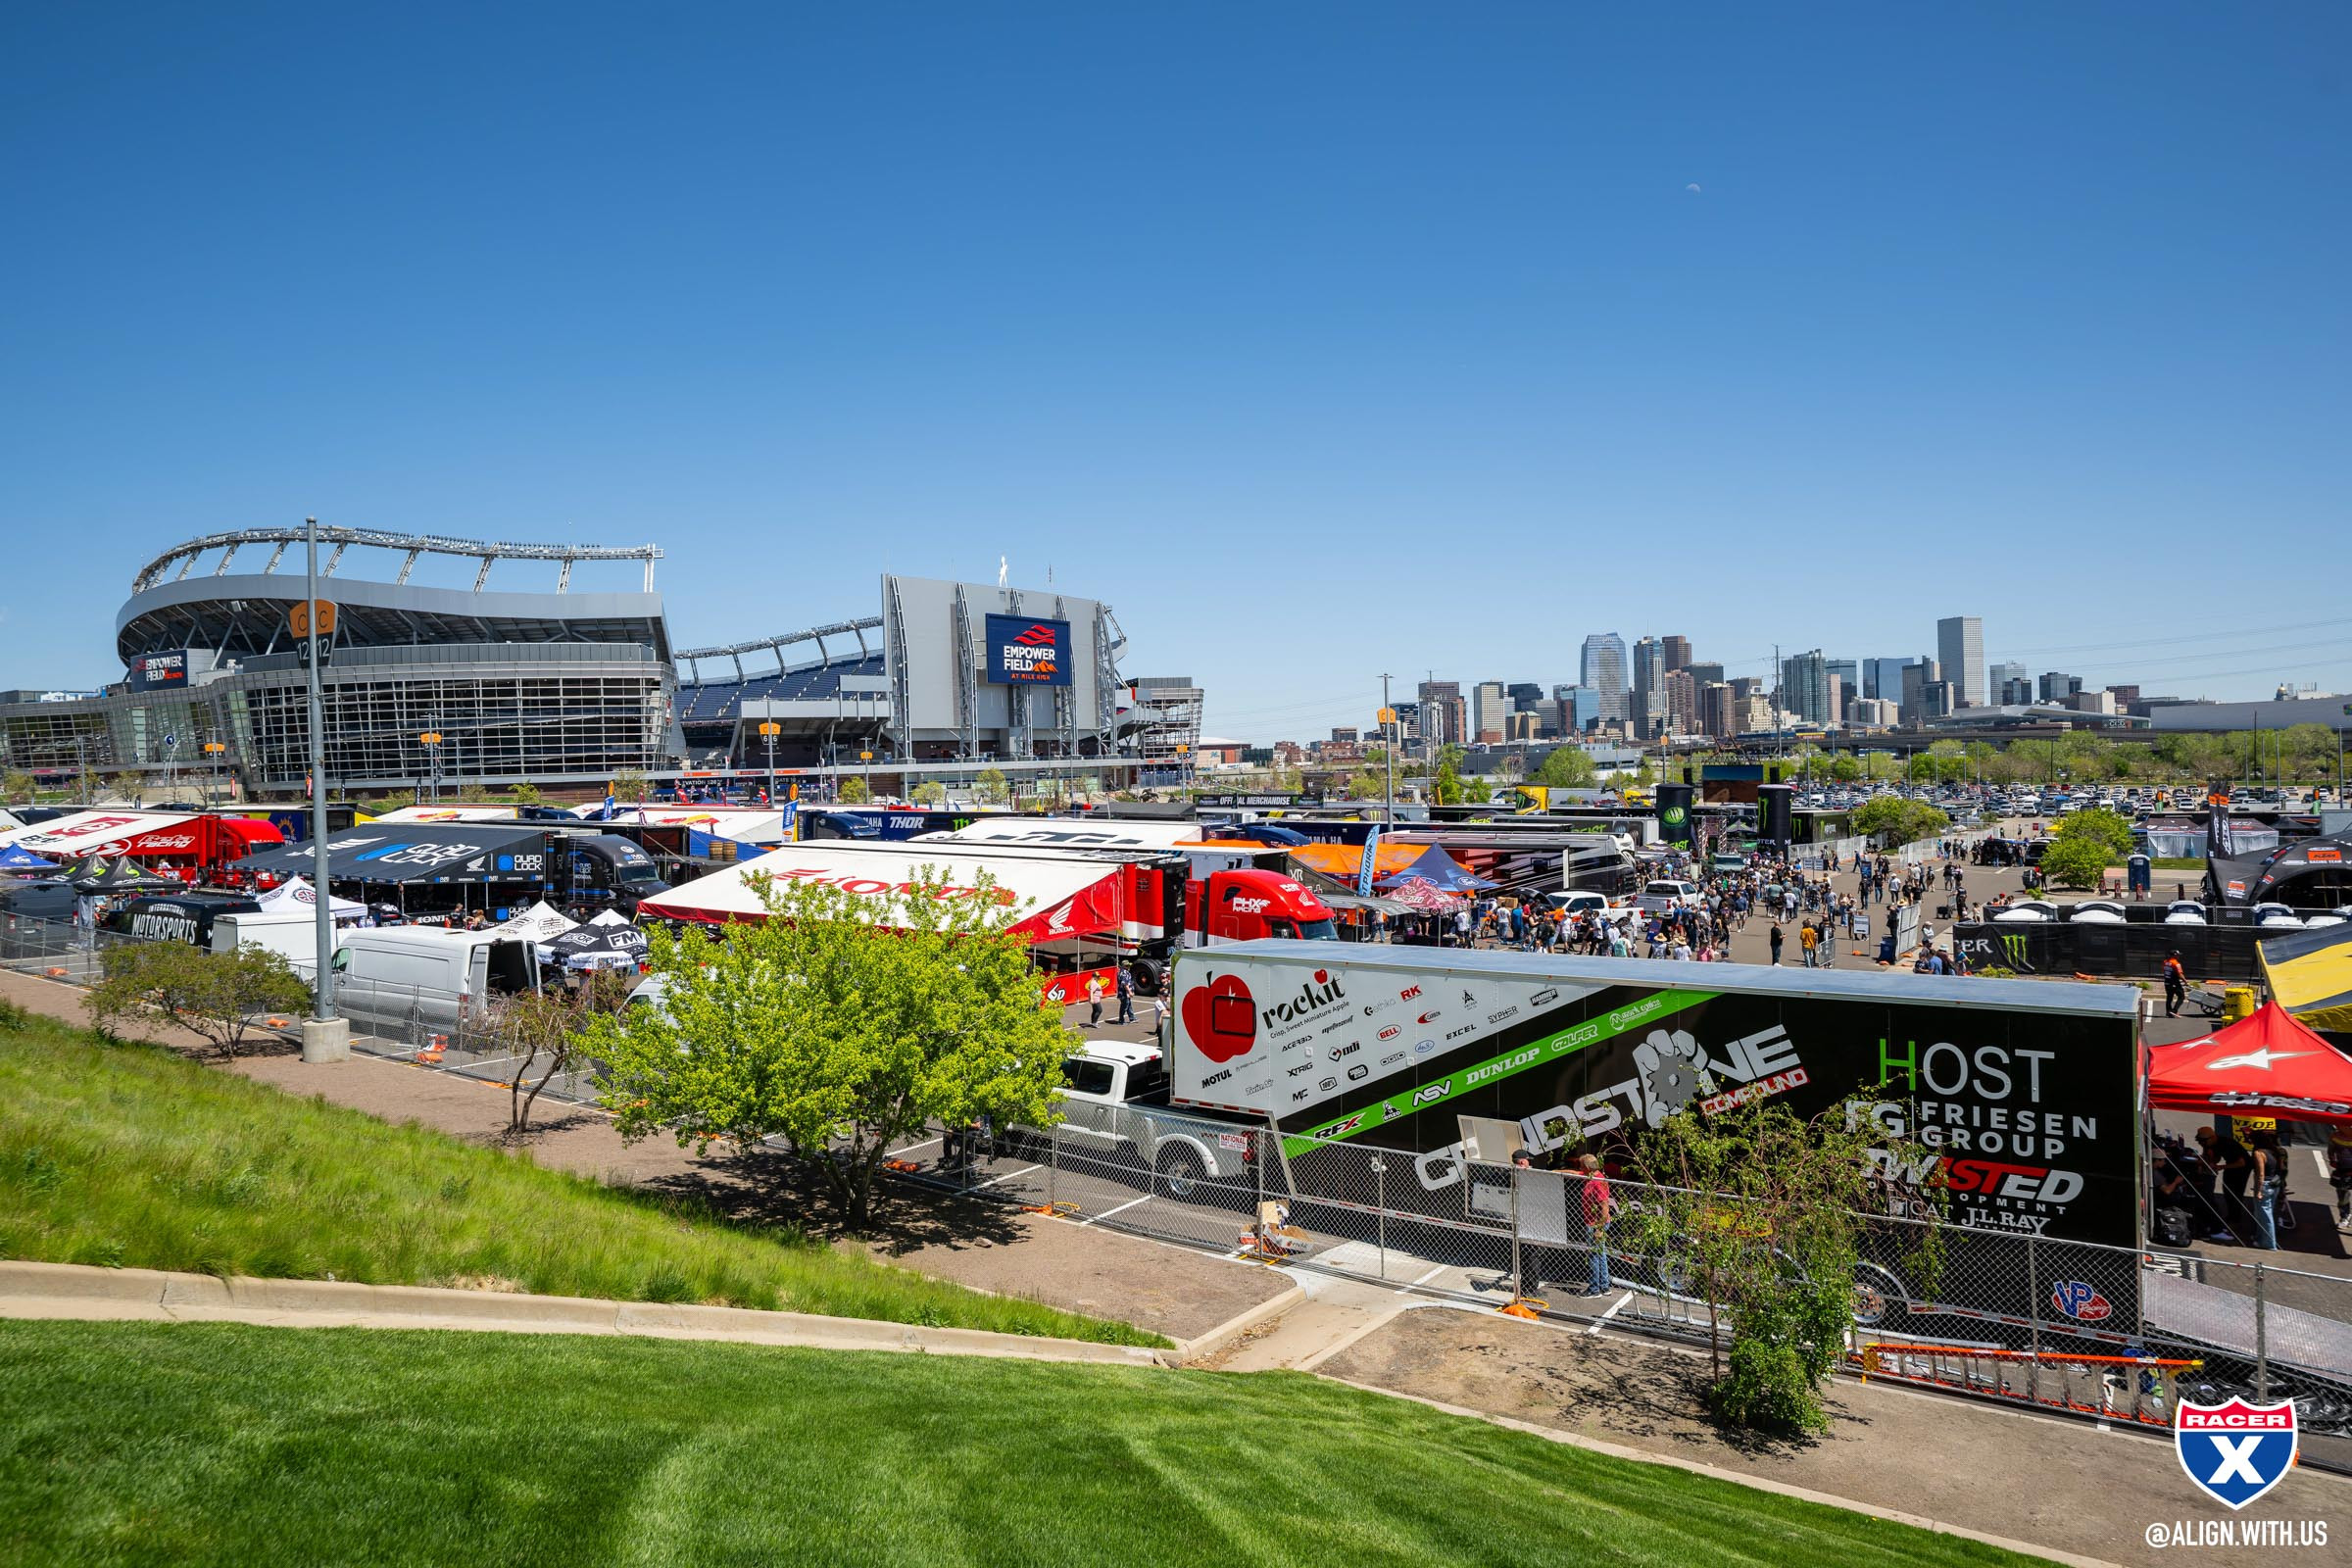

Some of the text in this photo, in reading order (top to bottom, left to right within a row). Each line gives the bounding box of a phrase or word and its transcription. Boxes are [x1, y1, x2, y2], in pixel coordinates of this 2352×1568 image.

[318, 611, 327, 629] C
[297, 638, 330, 662] 12 12
[1004, 646, 1055, 661] EMPOWER
[146, 656, 182, 671] EMPOWER
[1004, 659, 1034, 672] FIELD
[1219, 796, 1247, 806] OFFIAL
[1247, 796, 1292, 806] MERCHANDISE
[890, 816, 925, 829] THOR
[514, 855, 542, 863] QUAD
[514, 862, 542, 871] LOCK
[148, 903, 186, 917] INTERNATIONAL
[1233, 897, 1263, 907] PHX
[131, 912, 198, 945] MOTORSPORTS
[1049, 925, 1075, 936] HONDA
[1261, 969, 1347, 1030] rockit
[1400, 984, 1422, 1001] RK
[1531, 989, 1556, 1004] HAMMER
[1270, 1028, 1288, 1040] Crisp,
[1288, 1021, 1304, 1034] Sweet
[1303, 1008, 1333, 1028] Miniature
[1332, 1001, 1349, 1014] Apple
[1487, 1004, 1518, 1025] SYPHER
[1379, 1027, 1398, 1040] BELL
[1446, 1024, 1478, 1042] EXCEL
[1551, 1024, 1599, 1053] GALFER
[1282, 1034, 1313, 1053] ACERBIS
[1342, 1041, 1360, 1056] odi
[1287, 1061, 1314, 1078] XTRIG
[1465, 1047, 1541, 1086] DUNLOP
[1879, 1038, 2056, 1103] HOST
[1201, 1068, 1233, 1089] MOTUL
[1412, 1079, 1452, 1107] ASV
[1699, 1067, 1809, 1115] COMPOUND
[2208, 1090, 2352, 1115] alpinestars
[1383, 1110, 1402, 1122] enzo
[1921, 1101, 2097, 1140] FRIESEN
[1314, 1112, 1366, 1142] RFX
[1220, 1133, 1247, 1145] NATIONAL
[1921, 1124, 2066, 1160] GROUP
[1861, 1147, 2084, 1203] TWISTED
[1868, 1180, 2067, 1215] DEVEOPMENT
[2053, 1280, 2094, 1318] VP
